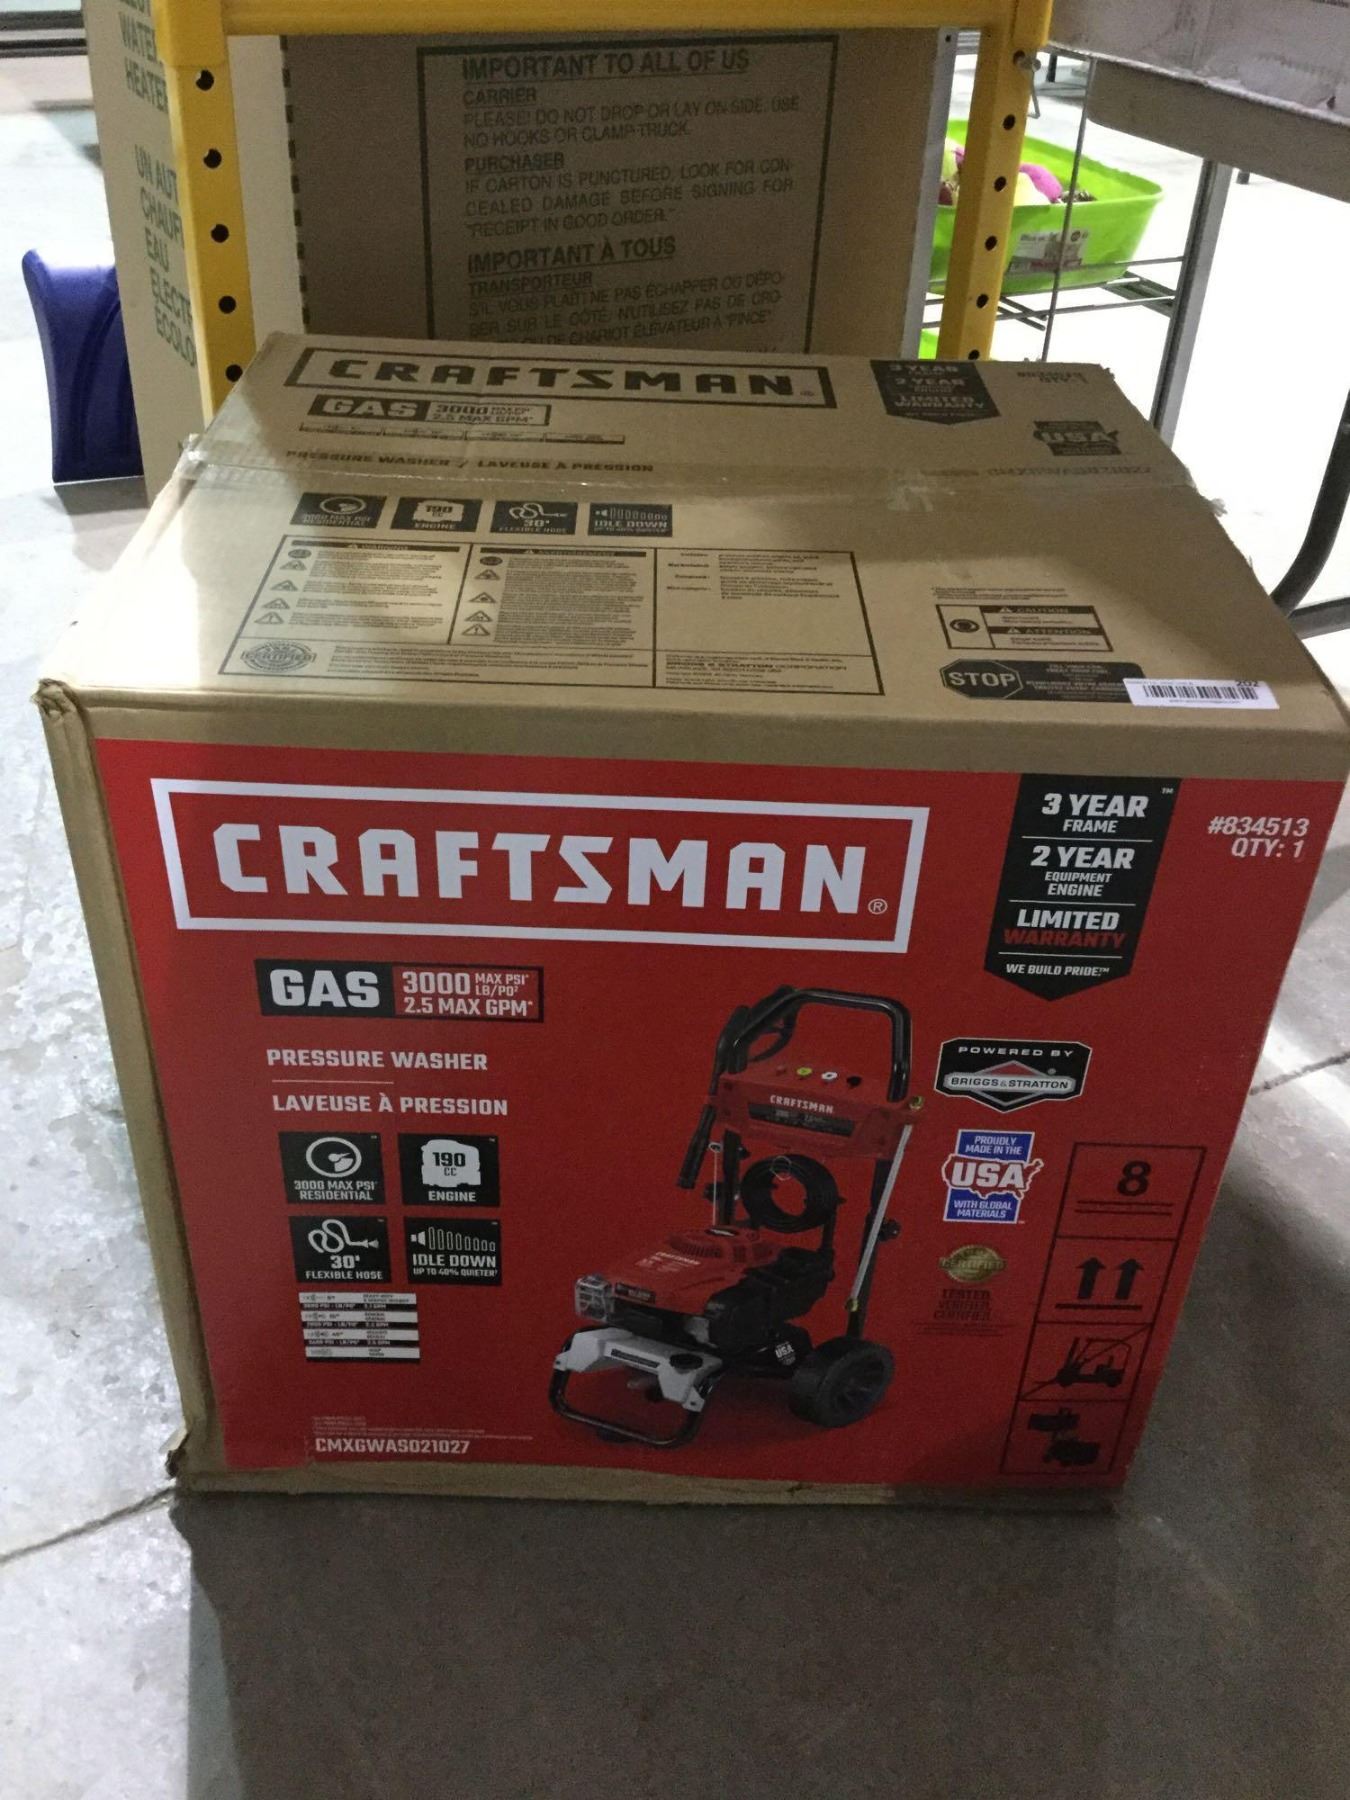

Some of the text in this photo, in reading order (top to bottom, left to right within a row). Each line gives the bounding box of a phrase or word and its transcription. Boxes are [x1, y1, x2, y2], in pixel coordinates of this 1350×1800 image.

[463, 48, 750, 80] IMPORTANT TO ALL OF US
[464, 87, 537, 105] CARRIER
[536, 108, 558, 124] DO
[564, 106, 596, 123] NOT
[601, 104, 643, 121] DROP
[648, 103, 669, 118] OR
[674, 101, 700, 116] LAY
[464, 132, 488, 147] NO
[494, 128, 549, 146] HOOKS
[554, 126, 578, 143] OR
[464, 152, 564, 171] PURCHASER
[466, 180, 479, 193] IF
[485, 174, 552, 192] CARTON
[559, 172, 573, 188] IS
[680, 162, 719, 179] LOOK
[725, 160, 754, 176] FOR
[466, 178, 793, 216] CEALED DAMAGE BEFORE SIGNING FOR
[544, 217, 559, 233] IN
[563, 213, 608, 230] GOOD
[145, 227, 169, 272] EAU
[468, 236, 676, 273] IMPORTANT À TOUS
[468, 271, 593, 297] TRANSPORTEUR
[590, 289, 608, 304] NE
[614, 286, 641, 300] PAS
[506, 316, 537, 333] SUR
[544, 313, 561, 328] LE
[695, 296, 721, 311] PAS
[728, 292, 746, 307] DE
[329, 358, 793, 396] CRAFTSMAN
[322, 398, 418, 417] GAS
[286, 450, 372, 462] PRESSURE
[378, 455, 450, 466] WASHER
[477, 460, 551, 469] LAVEUSE
[572, 462, 653, 472] PRESSION
[627, 520, 667, 528] DOWN
[949, 672, 1016, 687] STOP
[1041, 792, 1149, 818] 3 YEAR
[1062, 819, 1117, 833] FRAME
[1208, 816, 1310, 837] #834513
[1030, 845, 1135, 869] 2 YEAR
[1232, 838, 1305, 858] QTY: 1
[213, 823, 866, 914] CRAFTSMAN
[1044, 871, 1112, 883] EQUIPMENT
[1047, 883, 1103, 897] ENGINE
[1017, 909, 1120, 930] LIMITED
[1004, 929, 1126, 948] WARRANTY
[1006, 963, 1062, 975] WE BUILD
[270, 969, 380, 1008] GAS
[402, 971, 471, 995] 3000
[475, 972, 502, 984] MAX
[404, 996, 433, 1014] 2.5
[438, 998, 480, 1015] MAX
[266, 1049, 488, 1070] PRESSURE WASHER
[958, 1046, 1043, 1056] POWERED
[951, 1077, 999, 1087] BRIGGS
[1008, 1079, 1069, 1089] STRATTON
[273, 1092, 508, 1115] LAVEUSE À PRESSION
[770, 1094, 834, 1114] CRAFTSMAN
[965, 1144, 1022, 1155] MADE IN THE
[974, 1135, 1017, 1147] PROUDLY
[432, 1152, 466, 1167] 190
[443, 1168, 457, 1176] CC
[951, 1162, 1025, 1188] USA
[1116, 1160, 1150, 1196] 8
[294, 1180, 326, 1191] 3000
[327, 1181, 353, 1191] MAX
[300, 1190, 373, 1201] RESIDENTIAL
[428, 1190, 476, 1202] ENGINE
[953, 1200, 1012, 1210] WITH GLOBAL
[956, 1208, 1006, 1218] MATERIALS
[412, 1253, 496, 1268] IDLE DOWN
[305, 1270, 383, 1280] FLEXIBLE HOSE
[413, 1268, 424, 1276] UP
[426, 1268, 436, 1276] TO
[315, 1438, 470, 1454] CMXGWAS021027
